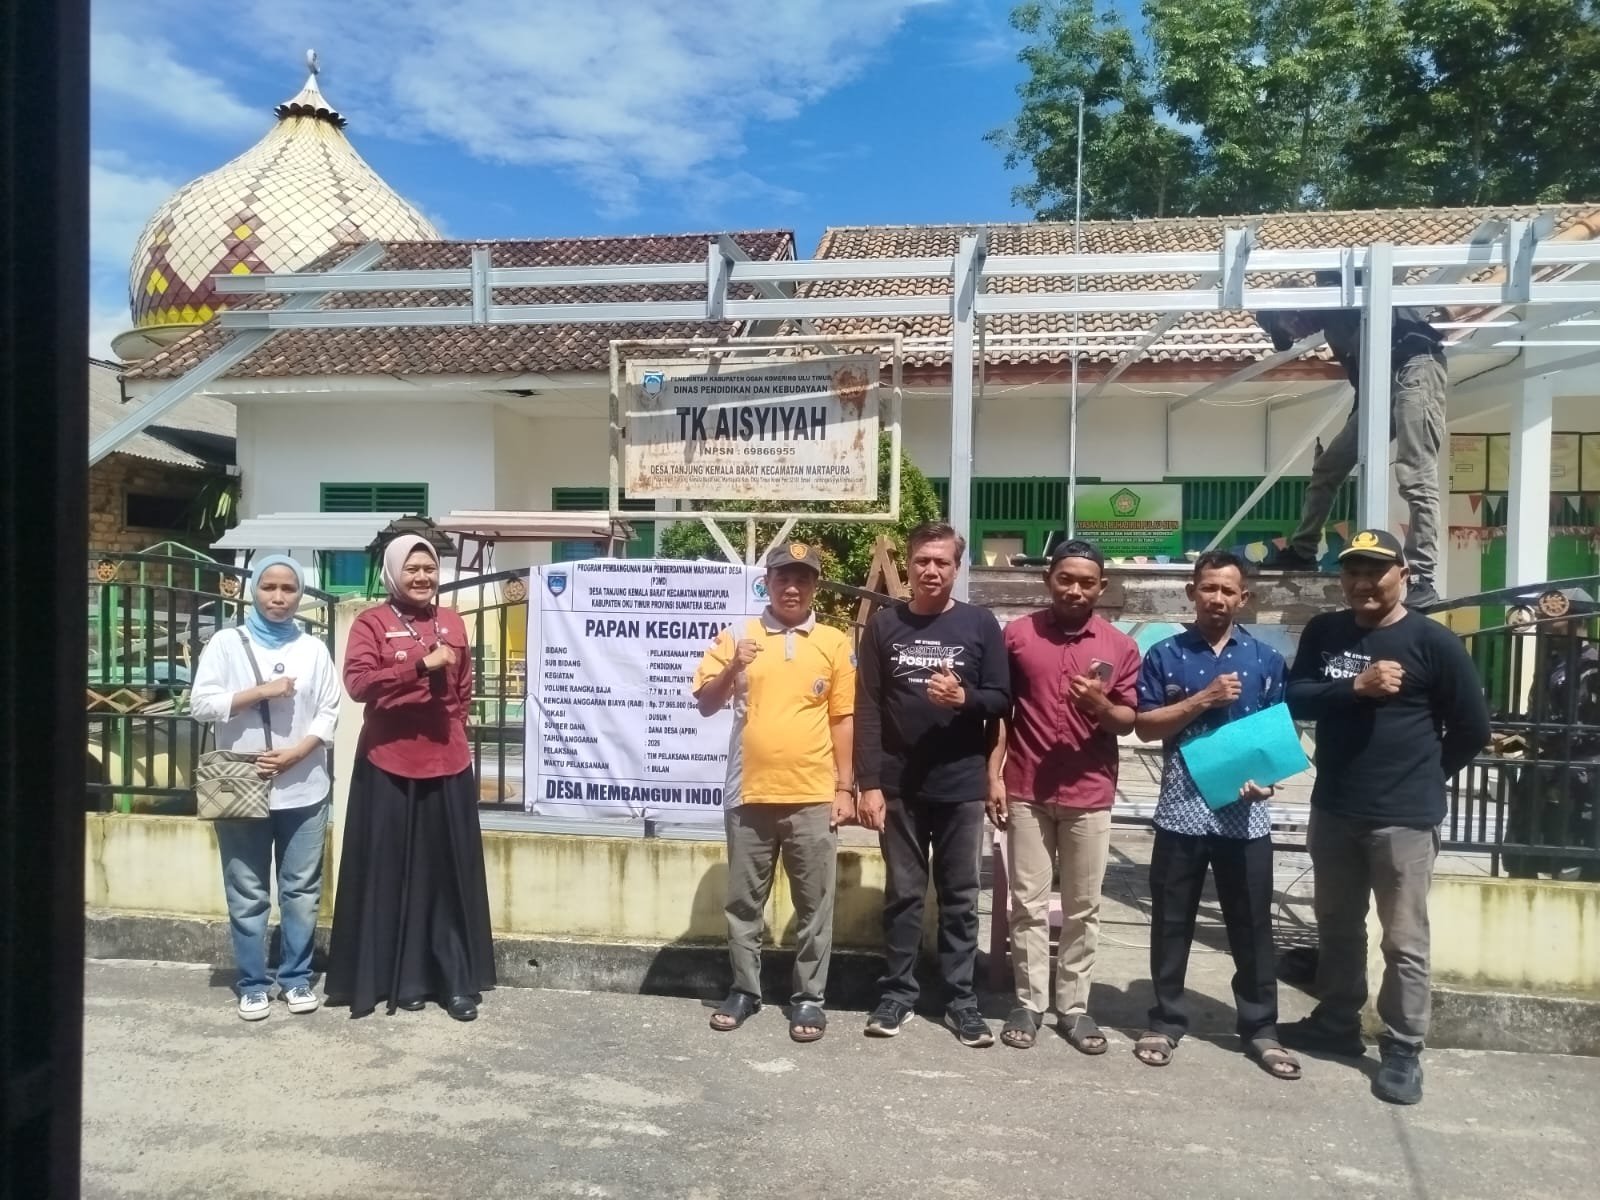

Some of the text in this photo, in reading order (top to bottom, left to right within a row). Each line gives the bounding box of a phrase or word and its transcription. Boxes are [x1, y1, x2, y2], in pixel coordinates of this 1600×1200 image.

[674, 384, 828, 394] DINAS PENDIDIKAN DAN KEBUDAYAAN
[676, 406, 826, 442] TK AISYIYAH
[704, 447, 734, 455] NPSN
[744, 447, 796, 455] 69866955
[650, 465, 850, 475] DESA TANJUNG KEMALA BARAT KECAMATAN MARTAPURA
[577, 564, 742, 574] PROGRAM PEMBANGUNAN DAN PEMBERDAYAAN MASYARAKAT DESA
[589, 587, 729, 598] DESA TANJUNG KEMALA BARAT KECAMATAN MARTAPURA
[592, 599, 726, 610] KABUPATEN OKU TIMUR PROVINSI SUMATERA SELATAN
[585, 619, 640, 638] PAPAN
[570, 685, 594, 693] RANGKA
[544, 697, 571, 705] RENCANA
[573, 698, 606, 706] ANGGARAN
[627, 700, 644, 708] (RAB)
[679, 728, 697, 736] (APBN)
[544, 734, 564, 742] TAHUN
[565, 736, 598, 744] ANGGARAN
[544, 747, 577, 755] PELAKSANA
[544, 759, 564, 767] WAKTU
[566, 761, 609, 769] PELAKSANAAN
[546, 780, 724, 805] DESA MEMBANGUN INDO
